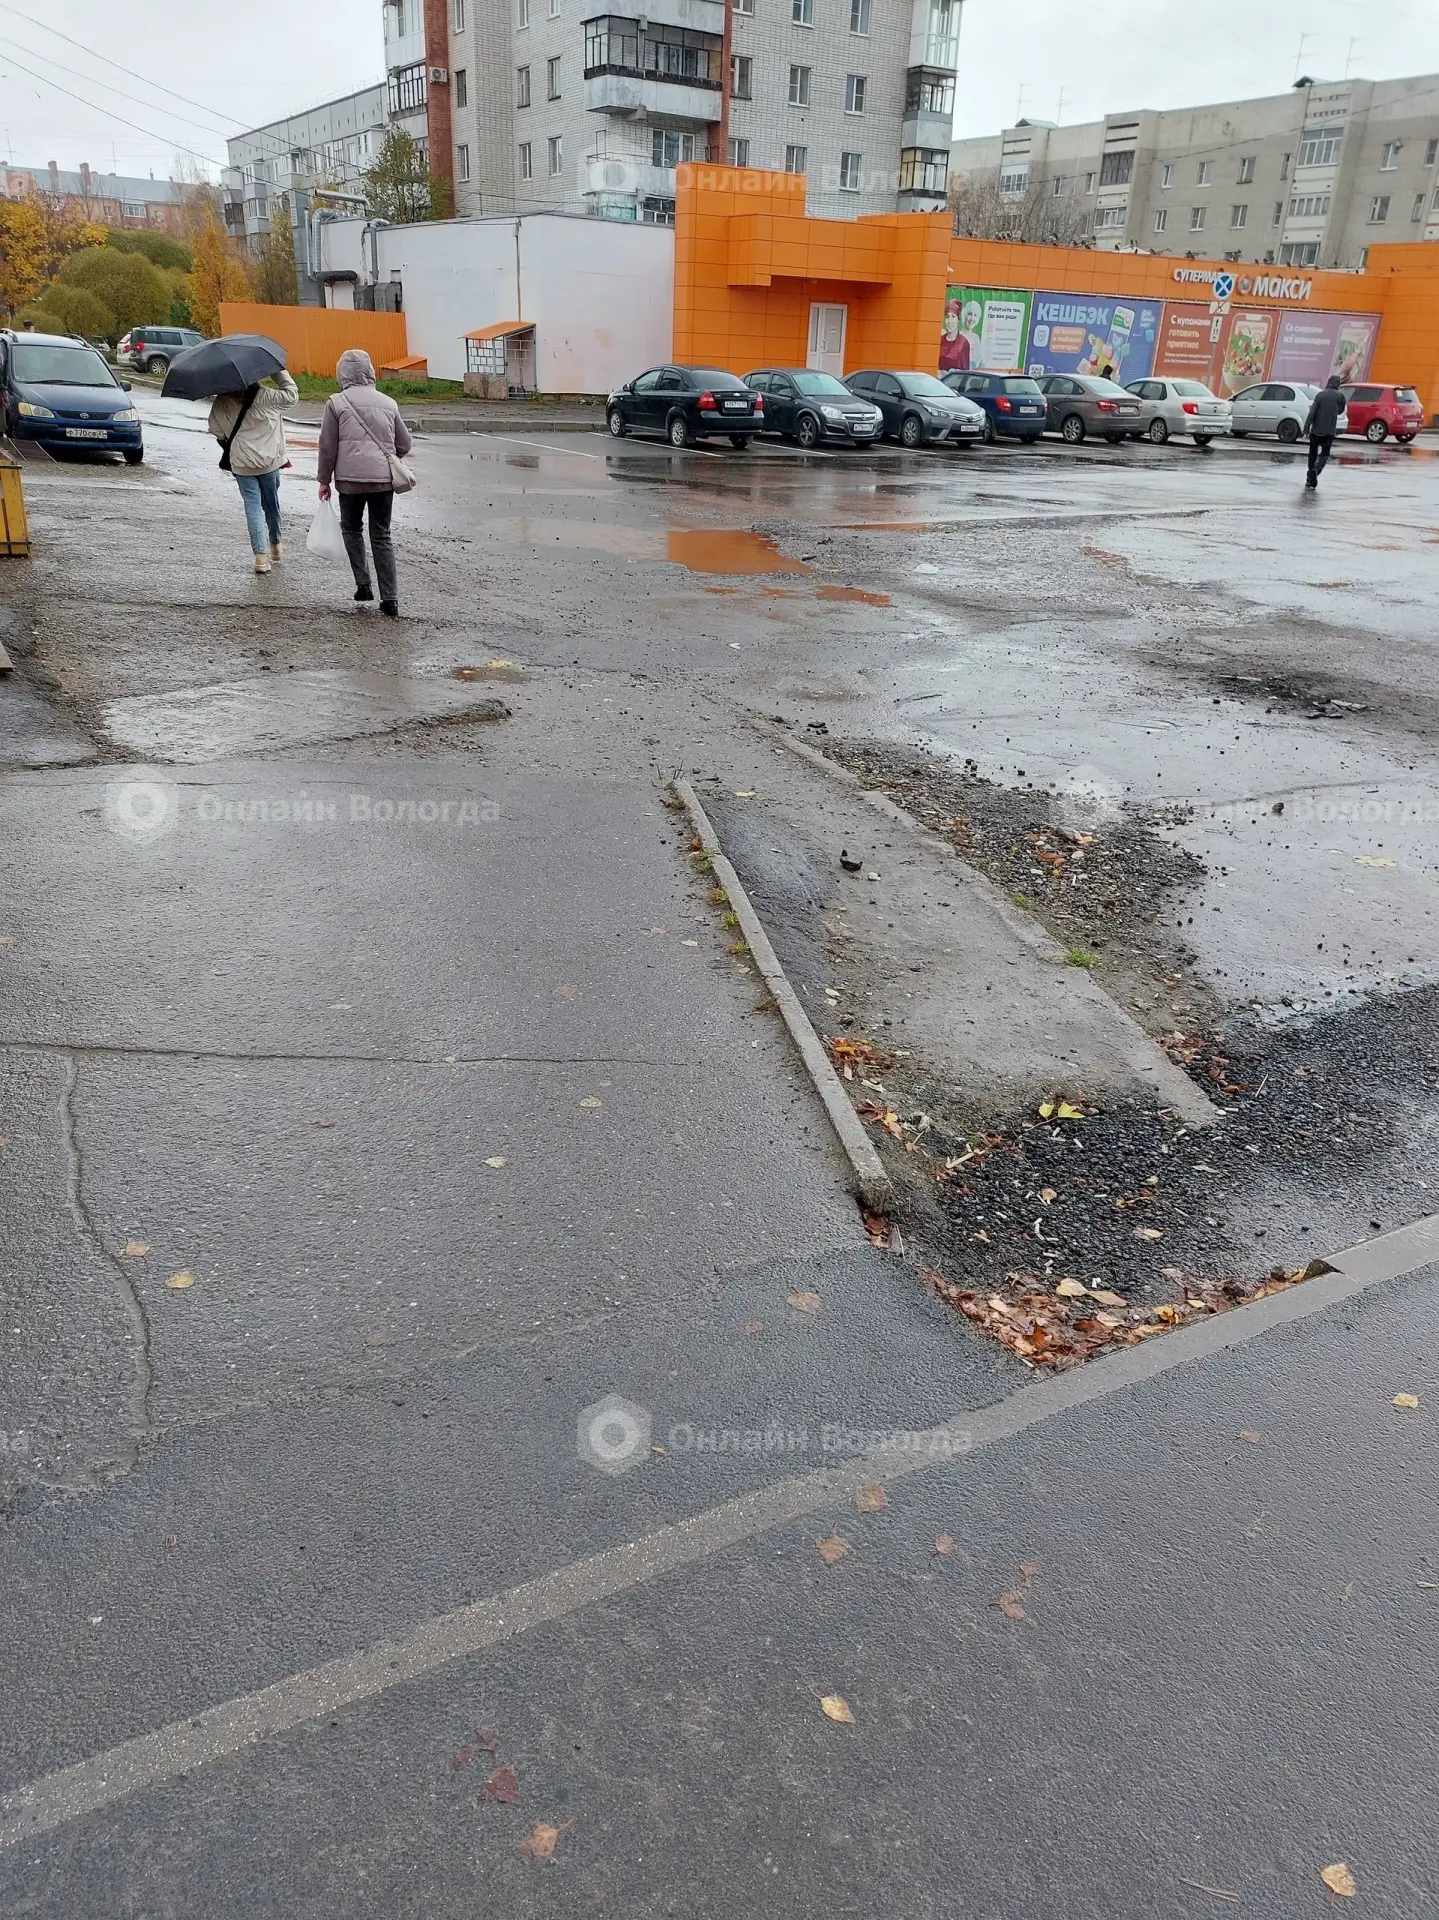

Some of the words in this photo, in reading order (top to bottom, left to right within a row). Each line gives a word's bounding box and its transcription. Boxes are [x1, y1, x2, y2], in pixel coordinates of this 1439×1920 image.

[1173, 267, 1238, 286] СУПЕРМА
[1036, 302, 1111, 326] КЕШБЭК
[1170, 314, 1177, 325] С
